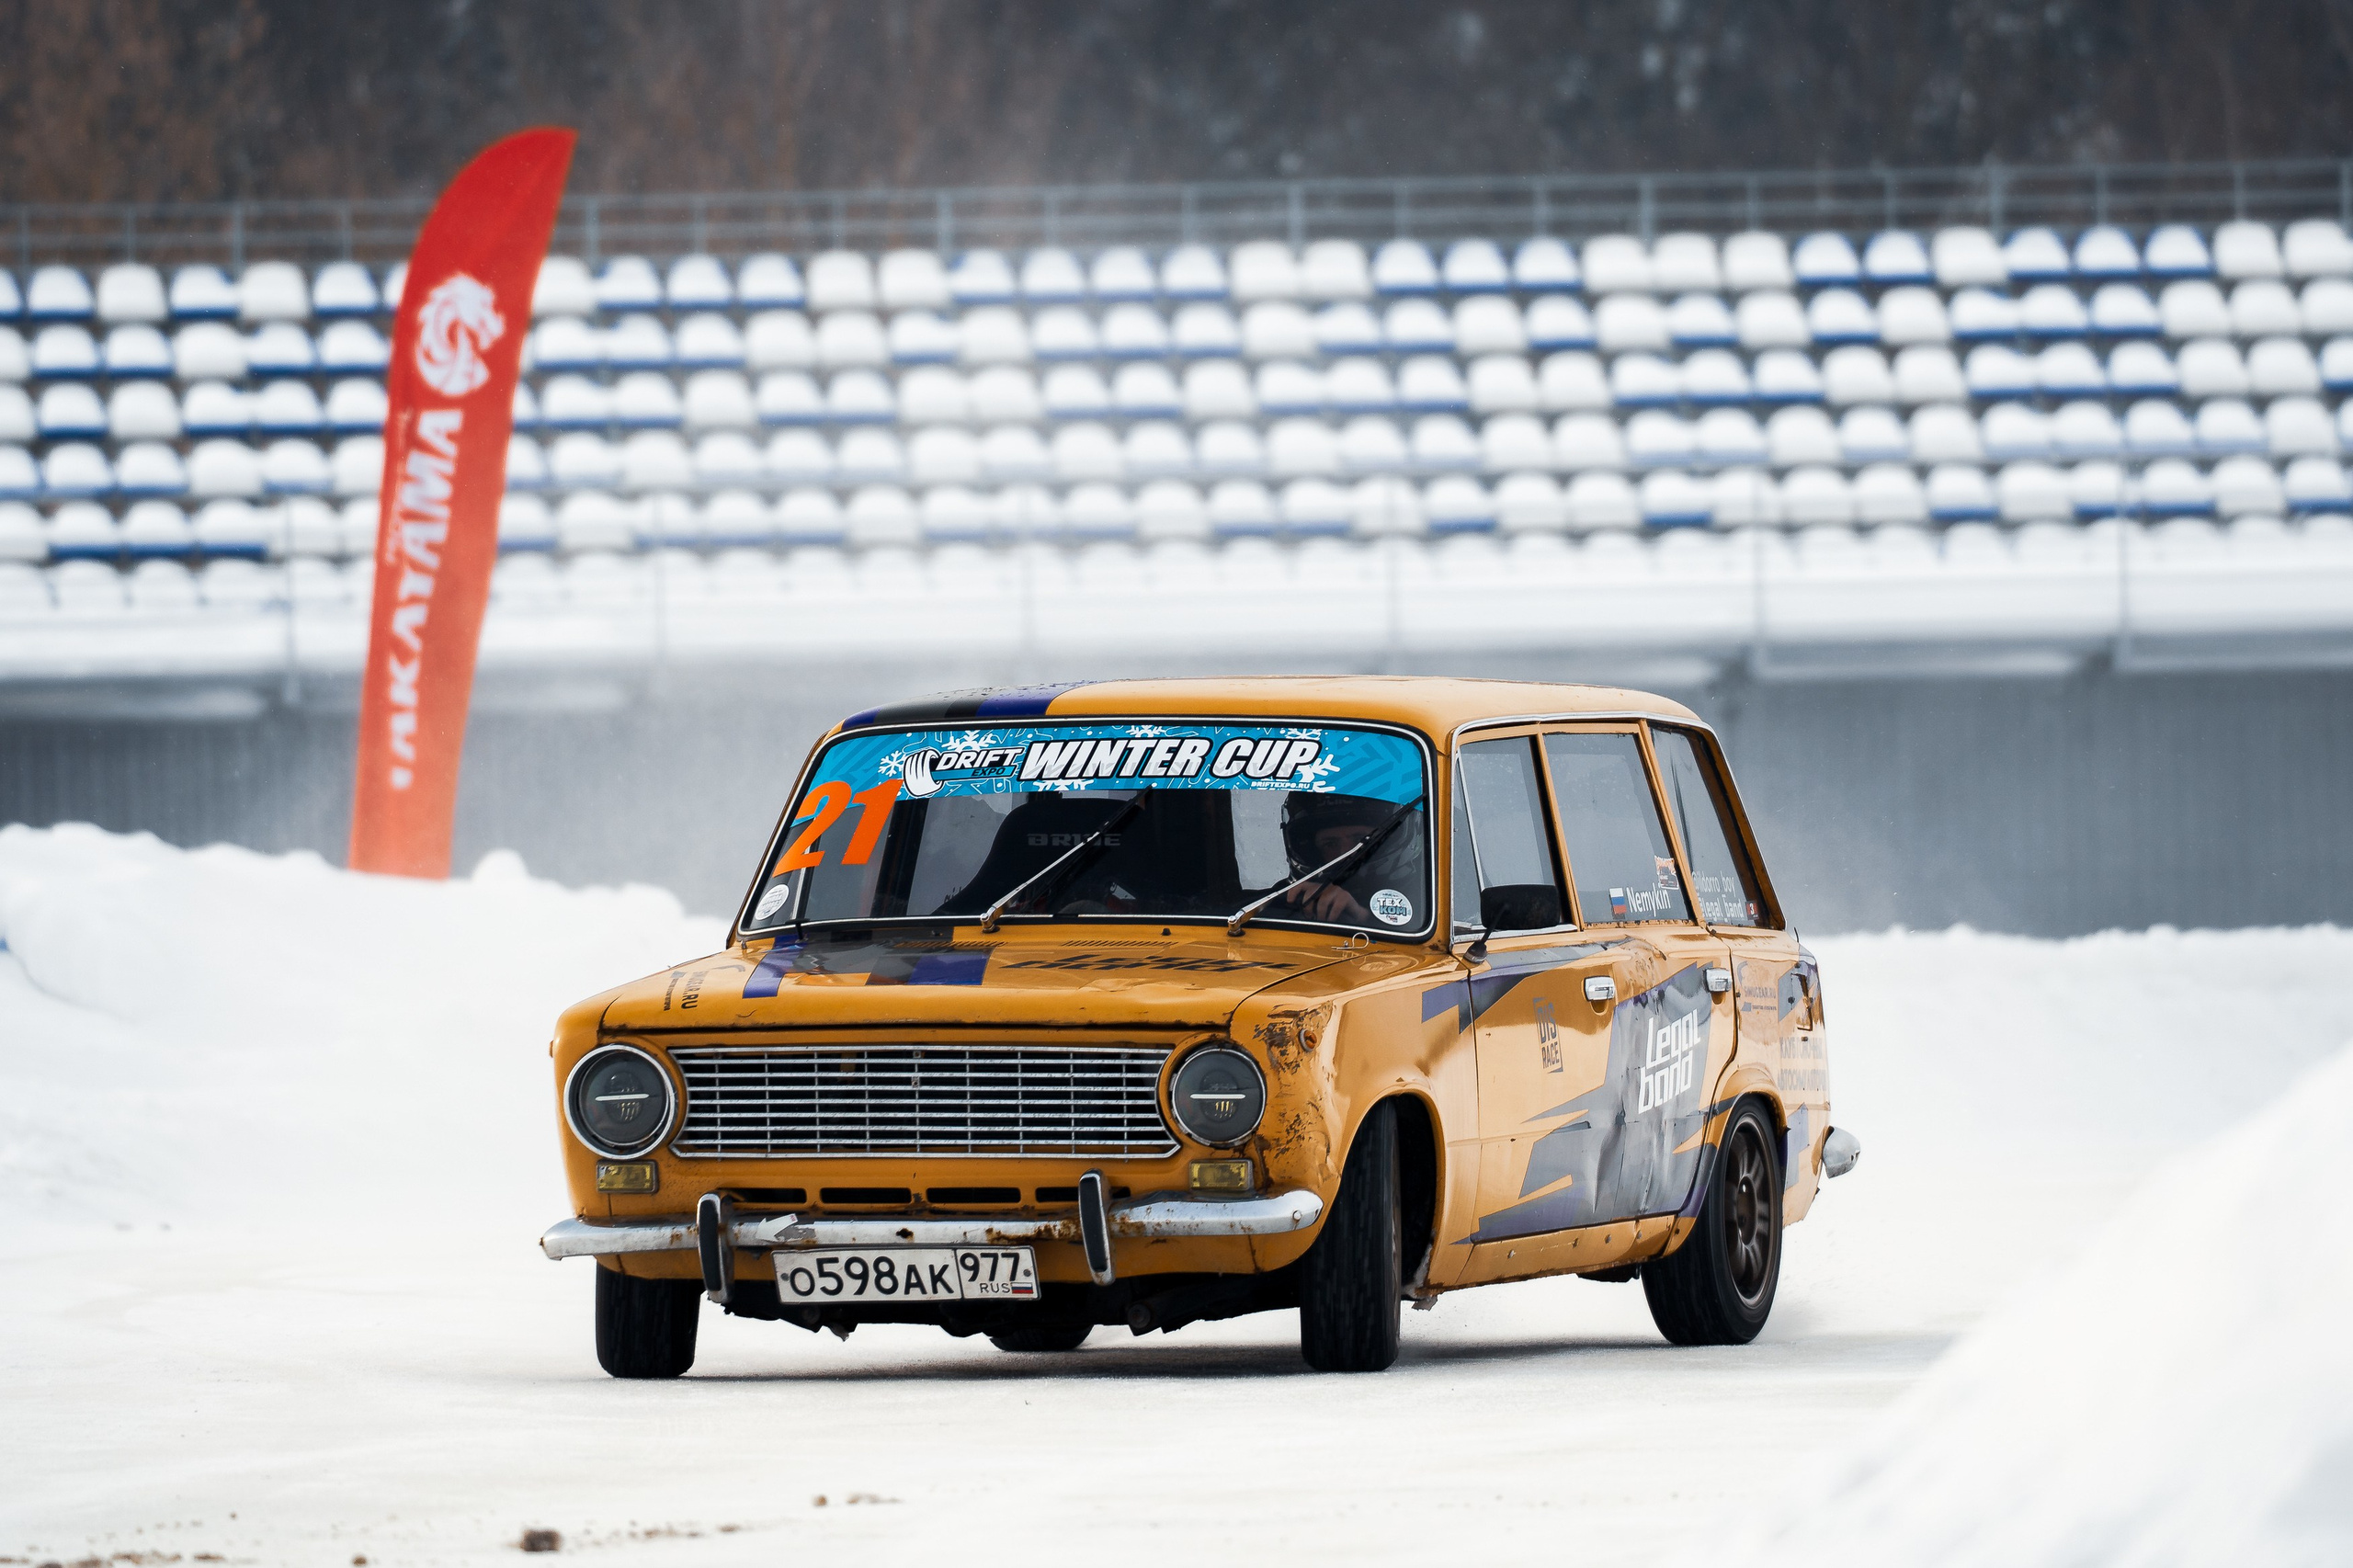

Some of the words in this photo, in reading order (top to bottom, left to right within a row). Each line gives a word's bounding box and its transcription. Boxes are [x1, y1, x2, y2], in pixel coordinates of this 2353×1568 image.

[936, 748, 1023, 771] DRIFT
[971, 767, 1006, 777] EXPO
[1018, 737, 1206, 780] WINTER
[1213, 737, 1320, 779] CUP
[1251, 781, 1310, 790] DRIFTEXPO.RU
[772, 779, 904, 878] 21
[1626, 882, 1671, 917] Nemykin
[1540, 1041, 1560, 1069] RACE
[960, 1252, 1020, 1282] 977
[980, 1282, 1011, 1294] RUS
